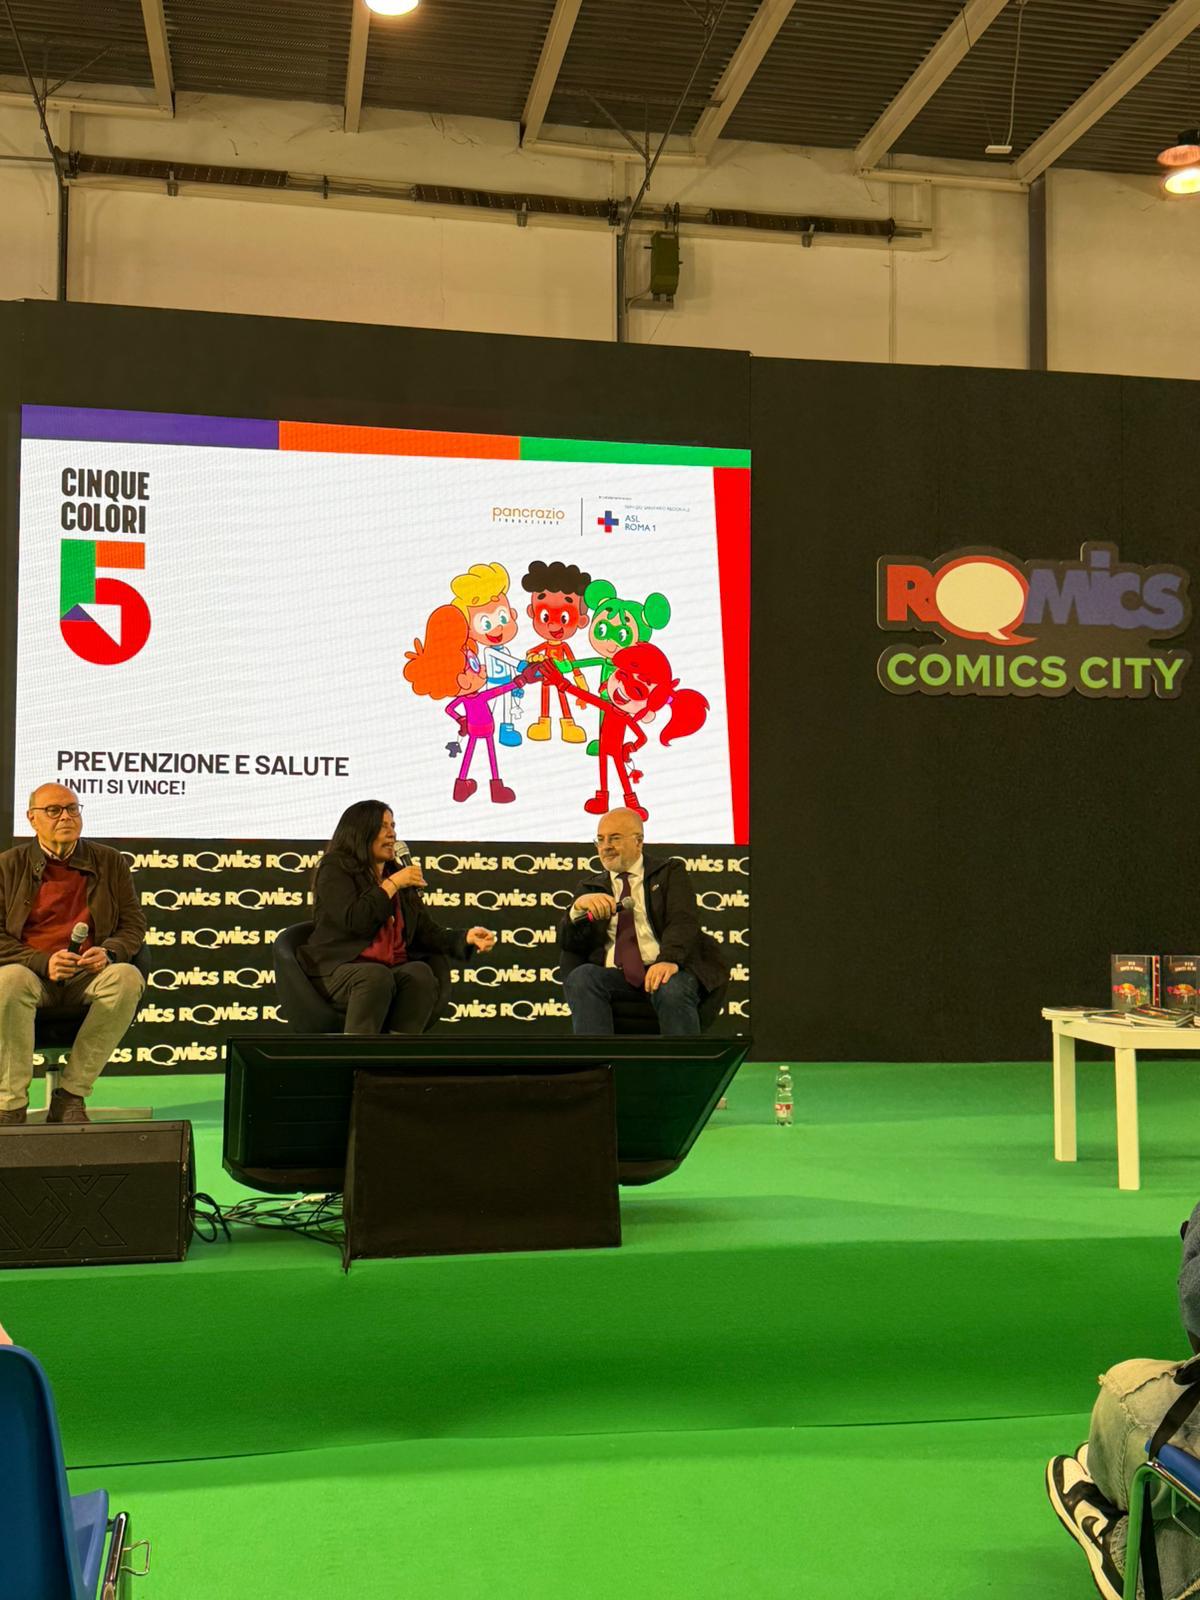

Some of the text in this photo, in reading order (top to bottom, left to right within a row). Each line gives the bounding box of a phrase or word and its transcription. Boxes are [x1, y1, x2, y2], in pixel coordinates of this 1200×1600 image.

[61, 467, 150, 502] CINQUE
[61, 502, 146, 534] COLORI
[492, 506, 565, 522] pancrazio
[624, 514, 641, 523] ASL
[624, 522, 650, 532] ROMA
[887, 653, 1184, 690] COMICS CITY
[57, 750, 350, 777] PREVENZIONE E SALUTE
[106, 779, 123, 795] SI
[127, 779, 186, 796] VINCE!
